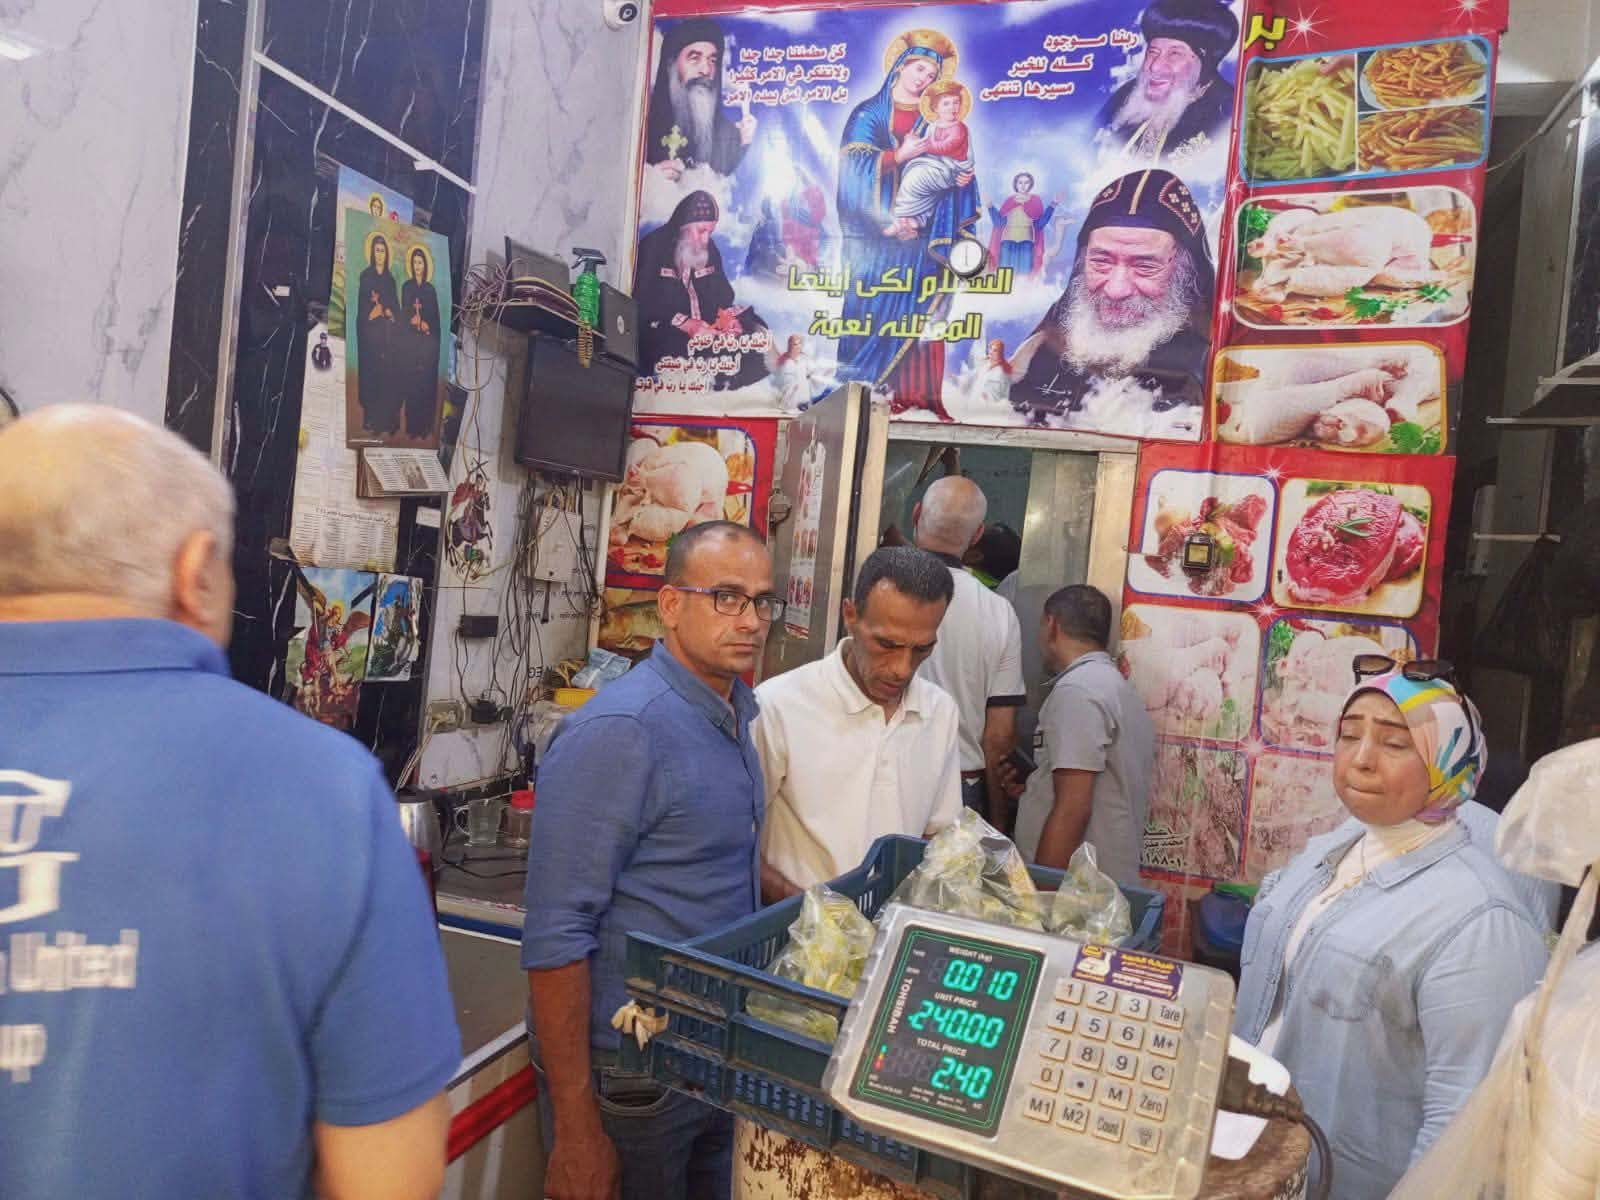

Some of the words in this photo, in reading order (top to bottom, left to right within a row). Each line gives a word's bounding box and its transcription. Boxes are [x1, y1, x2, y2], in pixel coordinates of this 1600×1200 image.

[1044, 33, 1108, 52] موجود
[1111, 29, 1138, 50] ربنا
[740, 47, 761, 64] جدا
[1008, 56, 1048, 77] للخير
[1049, 53, 1094, 72] كله
[1024, 80, 1074, 99] مسيرها
[856, 267, 913, 298] لكى
[917, 267, 1013, 304] السلام
[809, 310, 872, 339] نعمة
[934, 992, 952, 1003] UNIT
[953, 996, 978, 1008] PRICE
[1096, 990, 1109, 1005] 2
[1129, 998, 1141, 1013] 3
[1160, 1005, 1180, 1021] Tare
[1056, 1010, 1066, 1025] 4
[1088, 1018, 1101, 1033] 5
[1122, 1026, 1134, 1041] 6
[1153, 1034, 1175, 1049] M+
[917, 1037, 941, 1051] TOTAL
[942, 1044, 968, 1057] PRICE
[1049, 1037, 1060, 1051] 7
[1081, 1047, 1093, 1062] 8
[1116, 1055, 1128, 1071] 9
[1151, 1065, 1165, 1081] C
[931, 1055, 993, 1099] 2.40
[1040, 1067, 1052, 1082] 0
[1108, 1088, 1122, 1101] M
[1139, 1094, 1162, 1113] Zero
[1029, 1097, 1050, 1115] M1
[1062, 1106, 1085, 1124] M2
